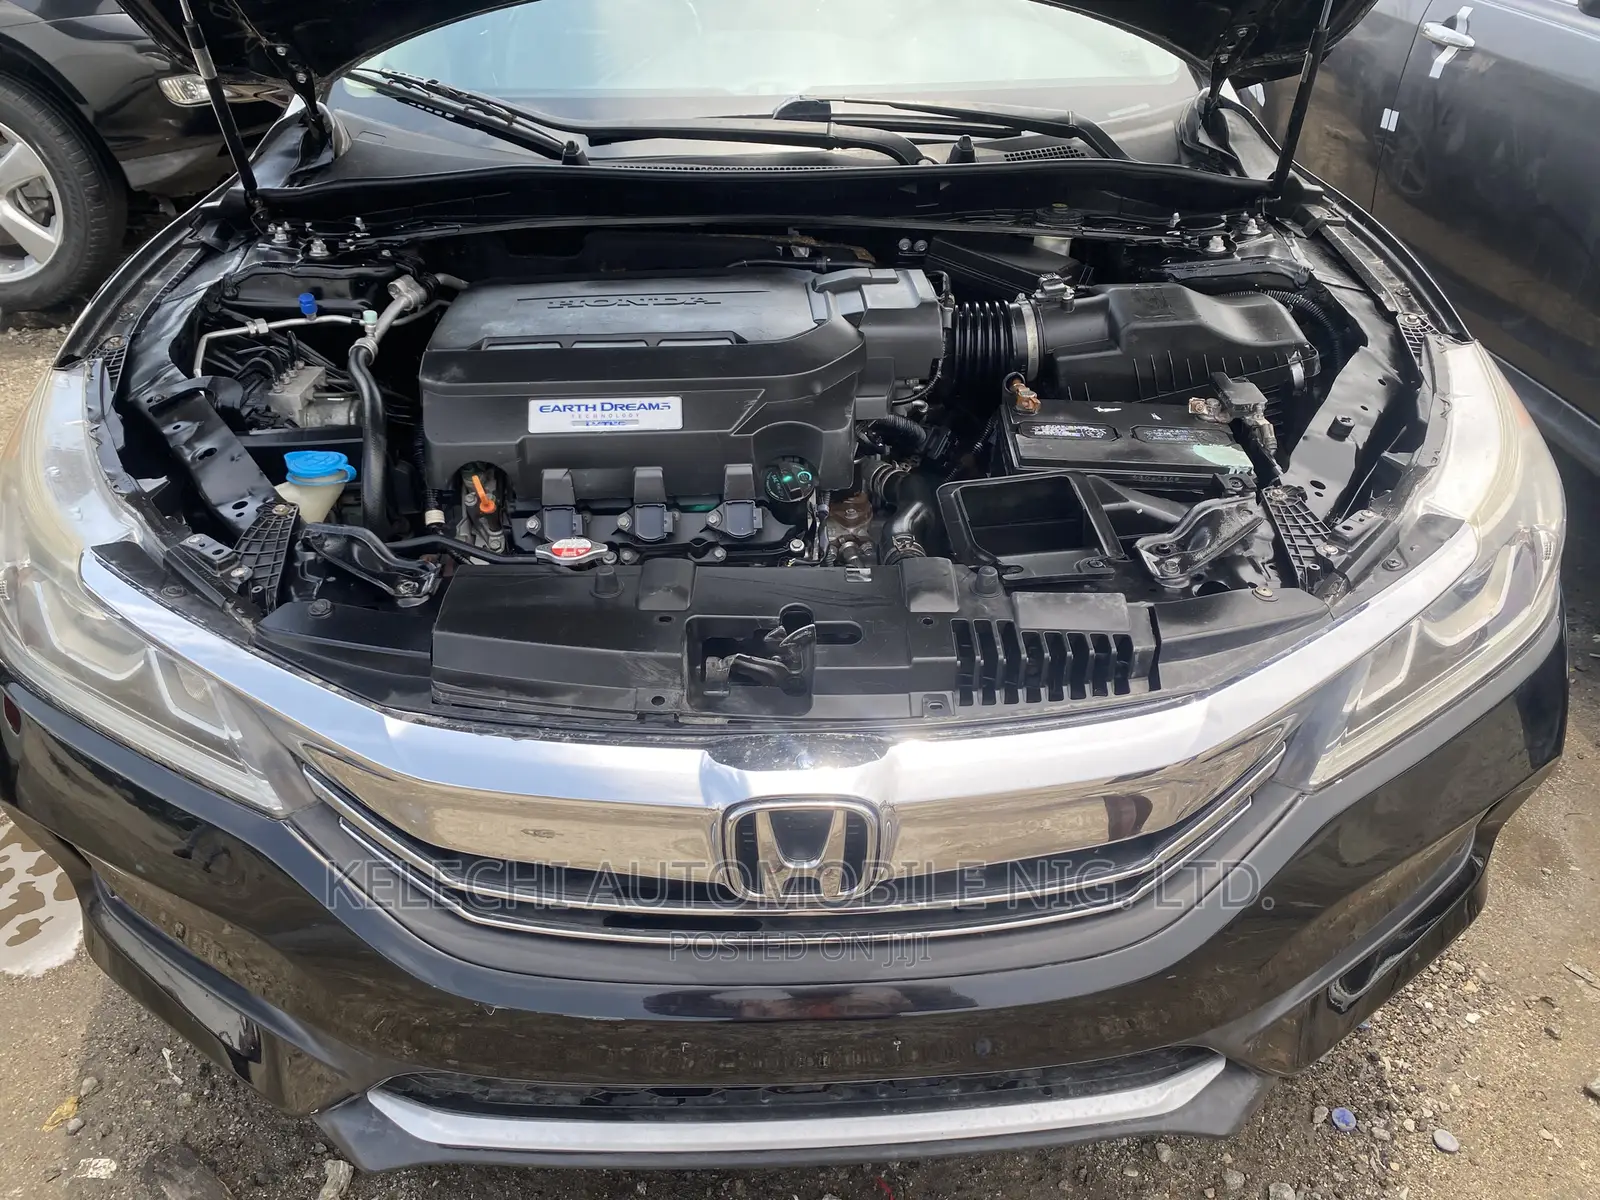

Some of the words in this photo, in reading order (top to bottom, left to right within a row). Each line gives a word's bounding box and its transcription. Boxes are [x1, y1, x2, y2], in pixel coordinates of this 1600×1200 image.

[547, 297, 721, 309] HONDA
[539, 403, 597, 413] EARTH
[600, 402, 671, 412] DREAMS
